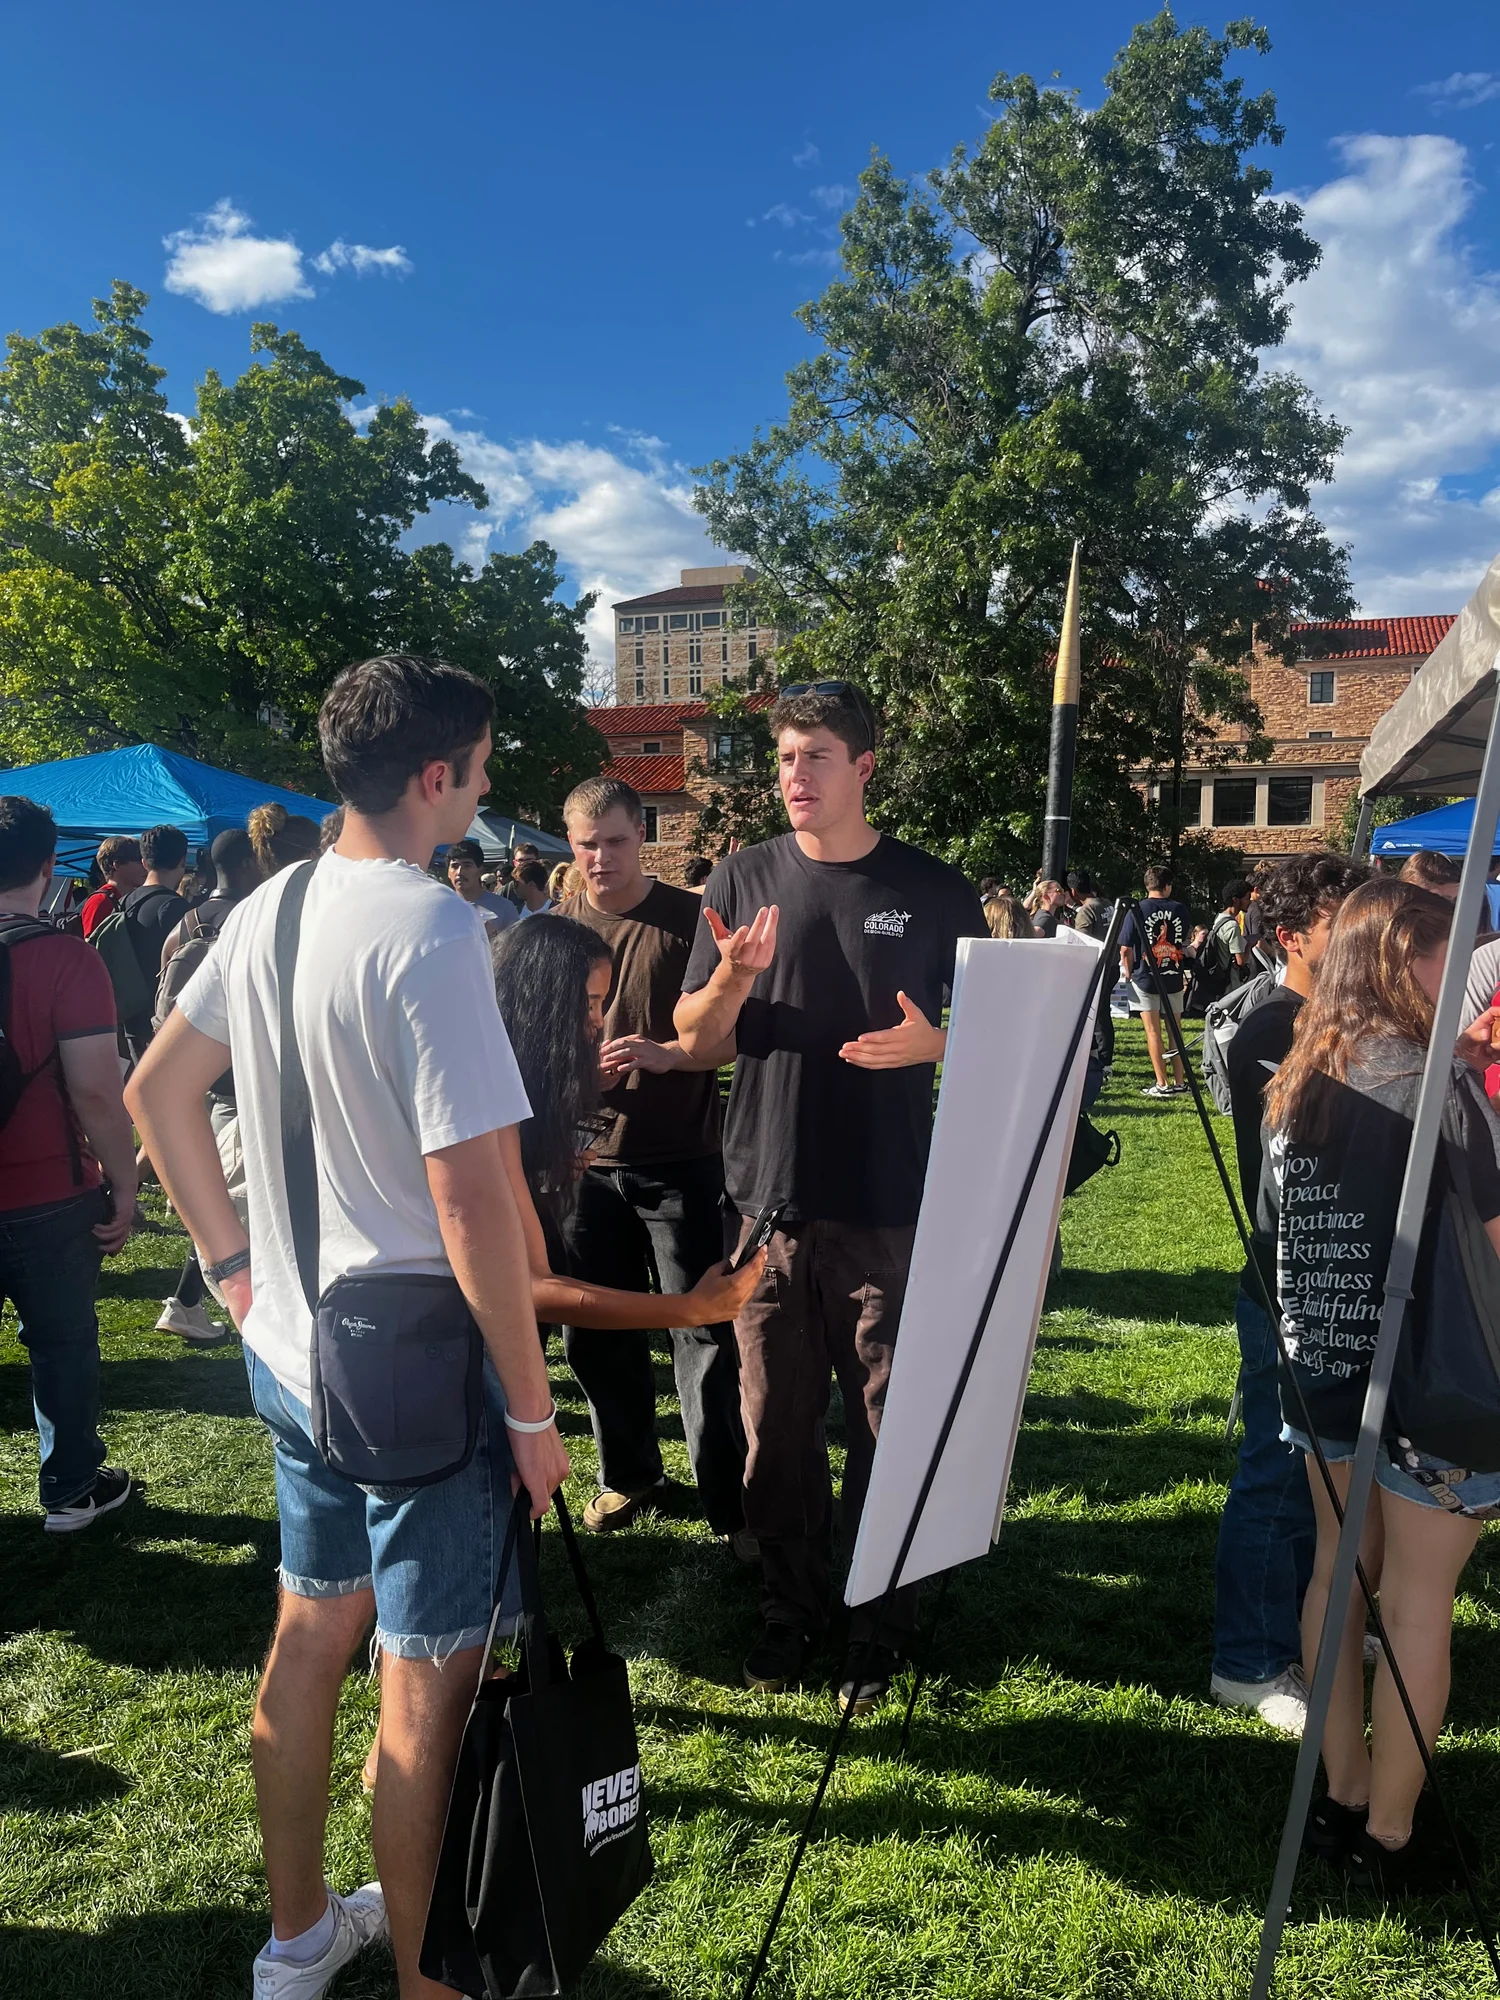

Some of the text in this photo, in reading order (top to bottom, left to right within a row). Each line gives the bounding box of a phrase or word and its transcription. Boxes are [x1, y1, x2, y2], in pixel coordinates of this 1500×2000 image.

[864, 921, 904, 934] COLORADO
[1172, 917, 1183, 944] HOLE
[1281, 1150, 1319, 1182] joy
[1284, 1183, 1340, 1211] peace
[1287, 1205, 1365, 1240] patince
